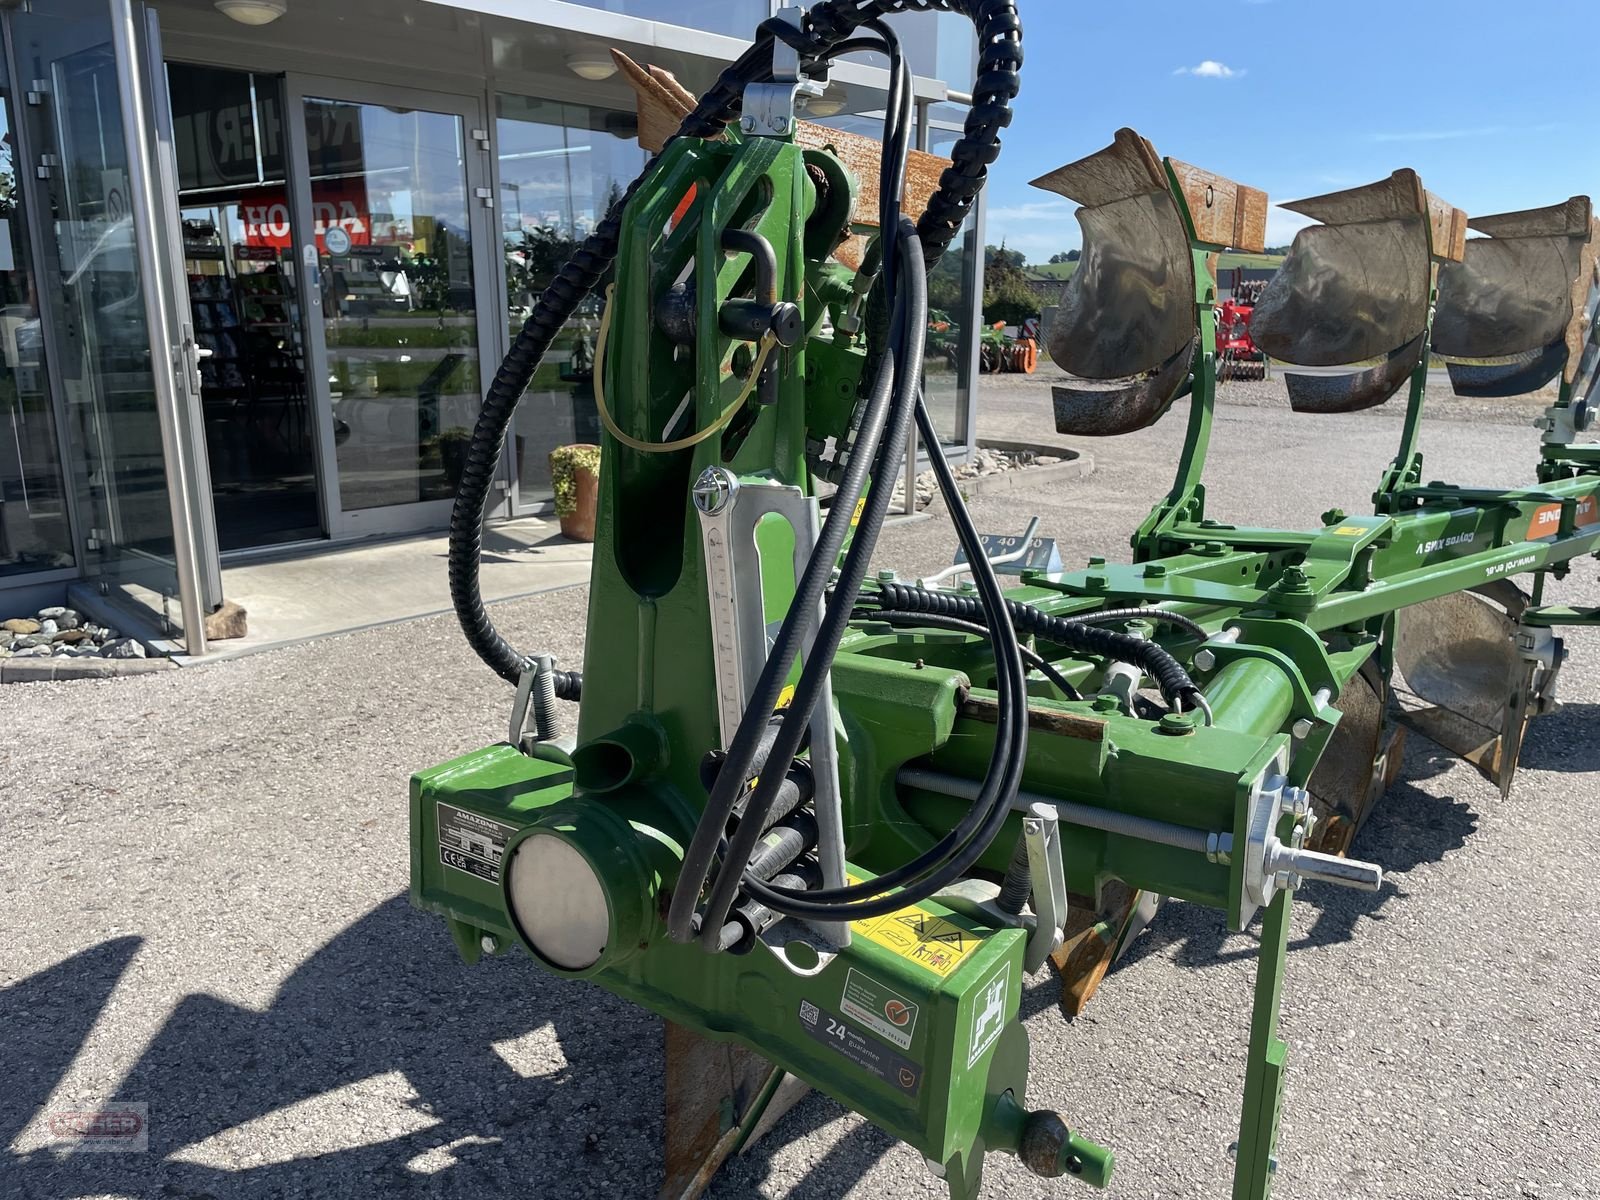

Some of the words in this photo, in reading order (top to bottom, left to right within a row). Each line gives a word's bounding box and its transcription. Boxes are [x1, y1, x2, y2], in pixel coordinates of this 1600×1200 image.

[244, 201, 367, 237] HODA
[997, 537, 1016, 546] 40
[456, 811, 499, 831] AMAZONE
[825, 1017, 847, 1041] 24
[846, 1031, 866, 1045] months
[848, 1040, 880, 1061] guarantee
